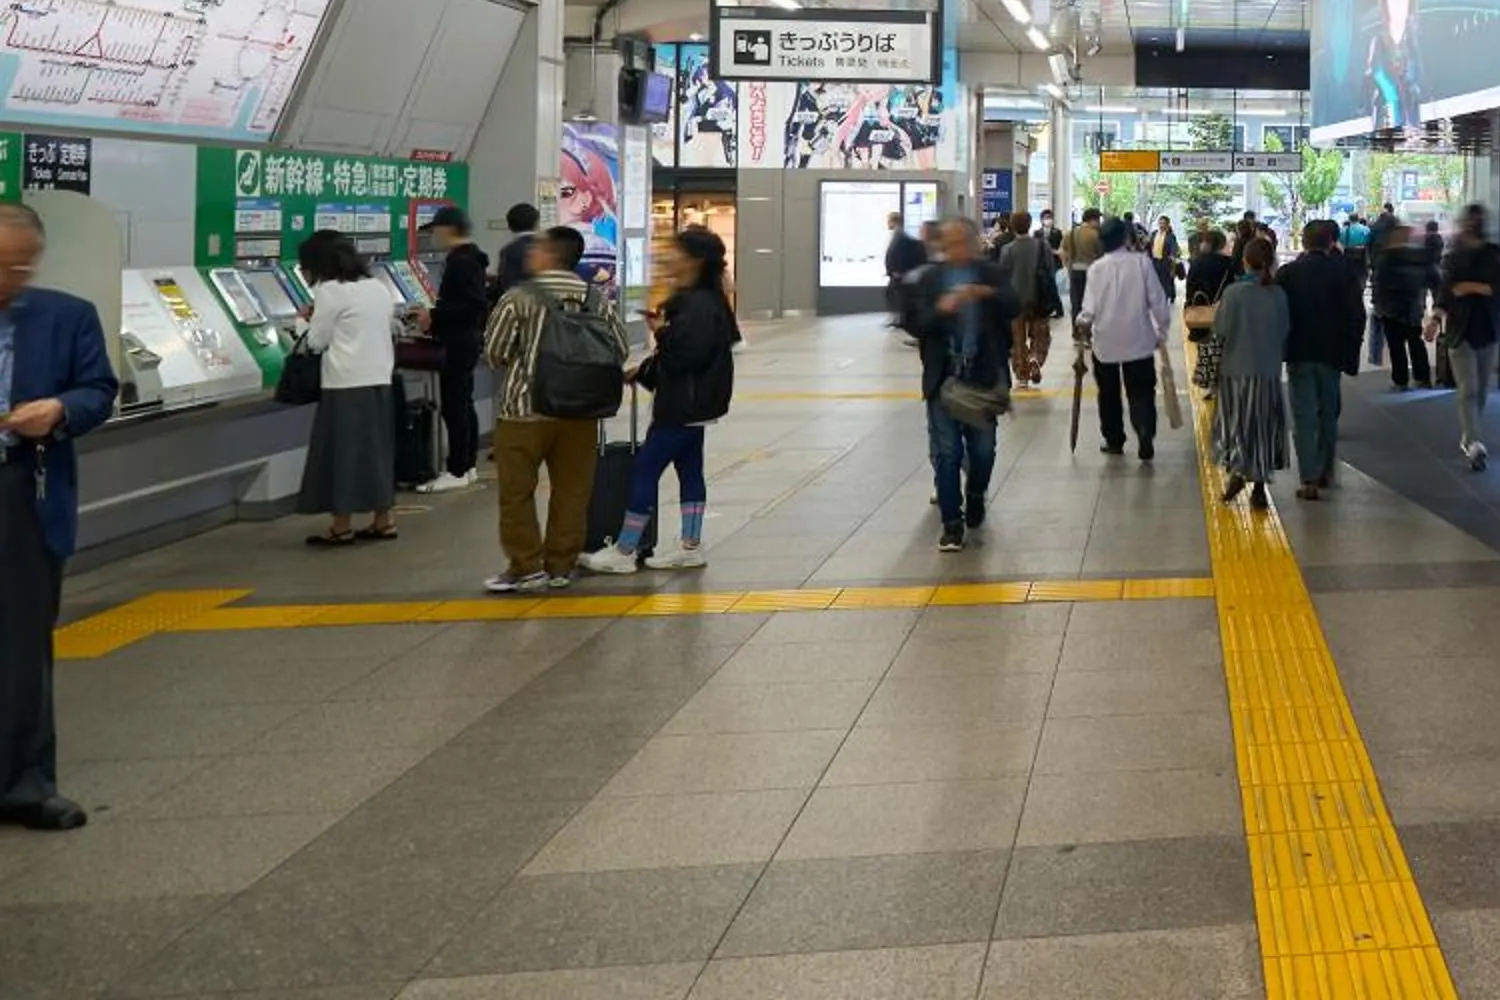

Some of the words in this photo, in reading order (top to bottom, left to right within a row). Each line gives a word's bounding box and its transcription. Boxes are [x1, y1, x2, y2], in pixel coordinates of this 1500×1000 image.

[779, 31, 898, 53] きっぷうりば
[779, 56, 825, 67] Tickets
